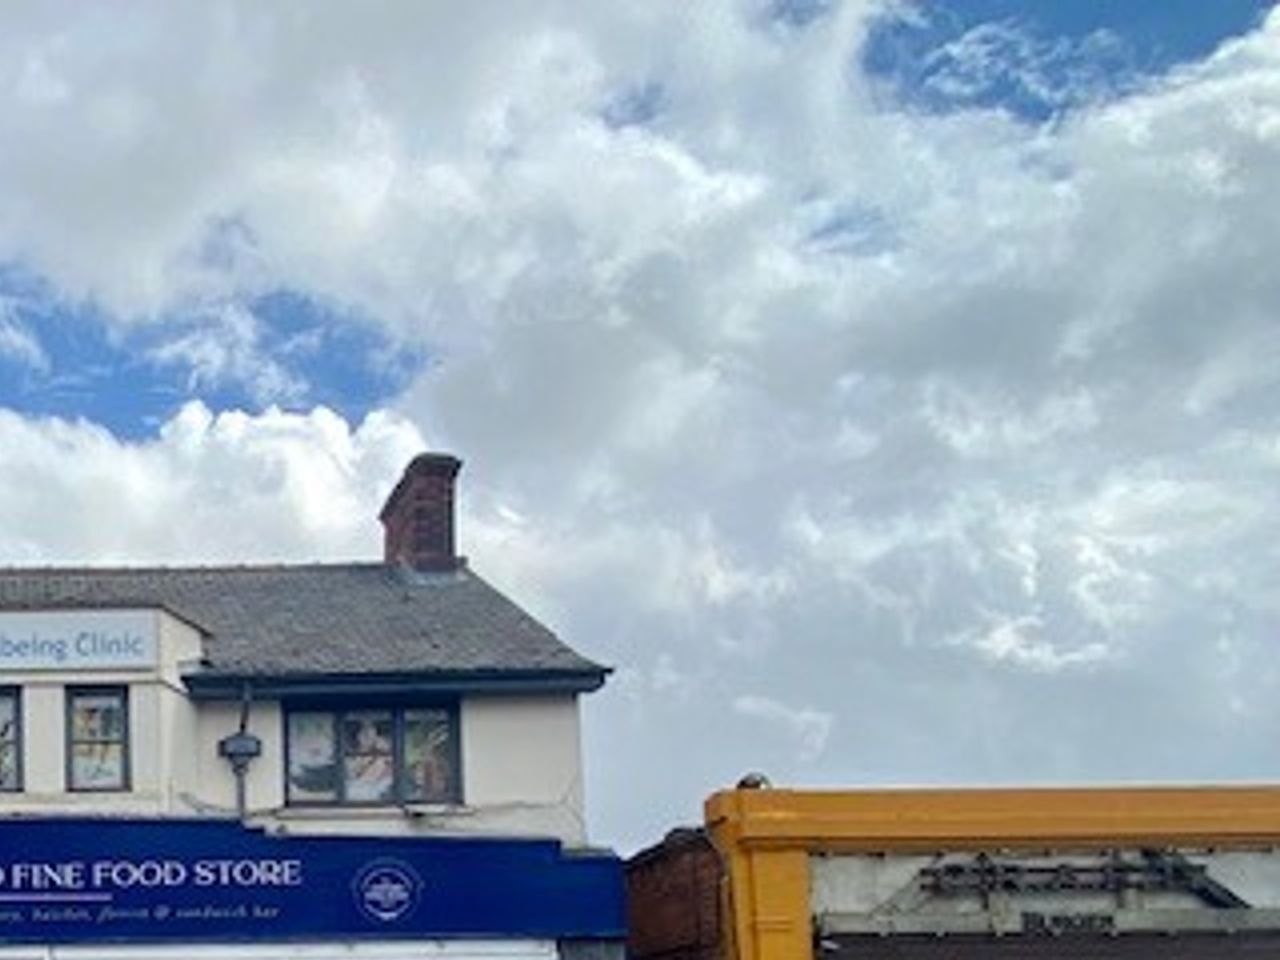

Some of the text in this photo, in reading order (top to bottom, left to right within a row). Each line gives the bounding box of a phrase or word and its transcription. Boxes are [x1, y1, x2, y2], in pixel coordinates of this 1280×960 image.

[75, 631, 145, 656] Clinic
[11, 861, 85, 888] FINE
[93, 861, 187, 886] FOOD
[193, 859, 302, 886] STORE
